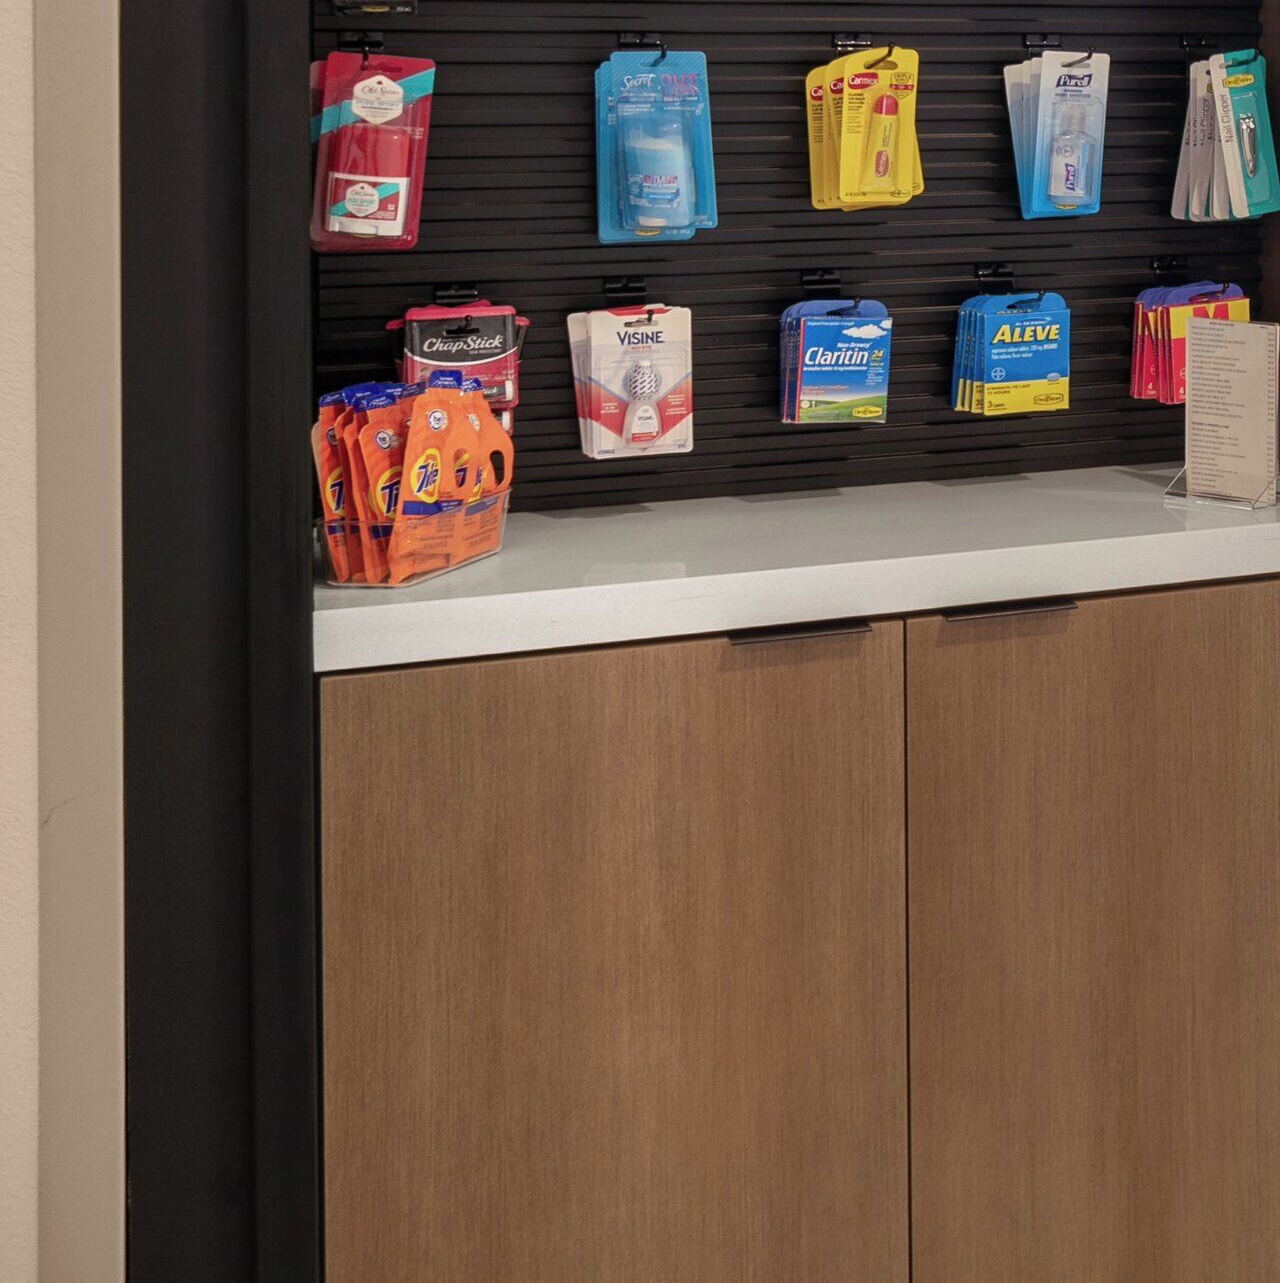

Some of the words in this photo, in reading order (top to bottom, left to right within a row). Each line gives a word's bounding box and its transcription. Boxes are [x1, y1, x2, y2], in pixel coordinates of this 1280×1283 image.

[621, 72, 657, 91] Secret
[848, 74, 880, 86] Carmex
[1057, 74, 1092, 88] Purell
[1220, 94, 1232, 125] Clipper
[1225, 124, 1235, 143] Nail
[422, 334, 504, 354] ChapStick
[616, 331, 664, 346] VISINE
[992, 324, 1061, 345] ALEVE
[804, 347, 868, 366] Claritin
[871, 350, 884, 360] 24
[987, 400, 993, 408] 3
[414, 452, 440, 494] Tide
